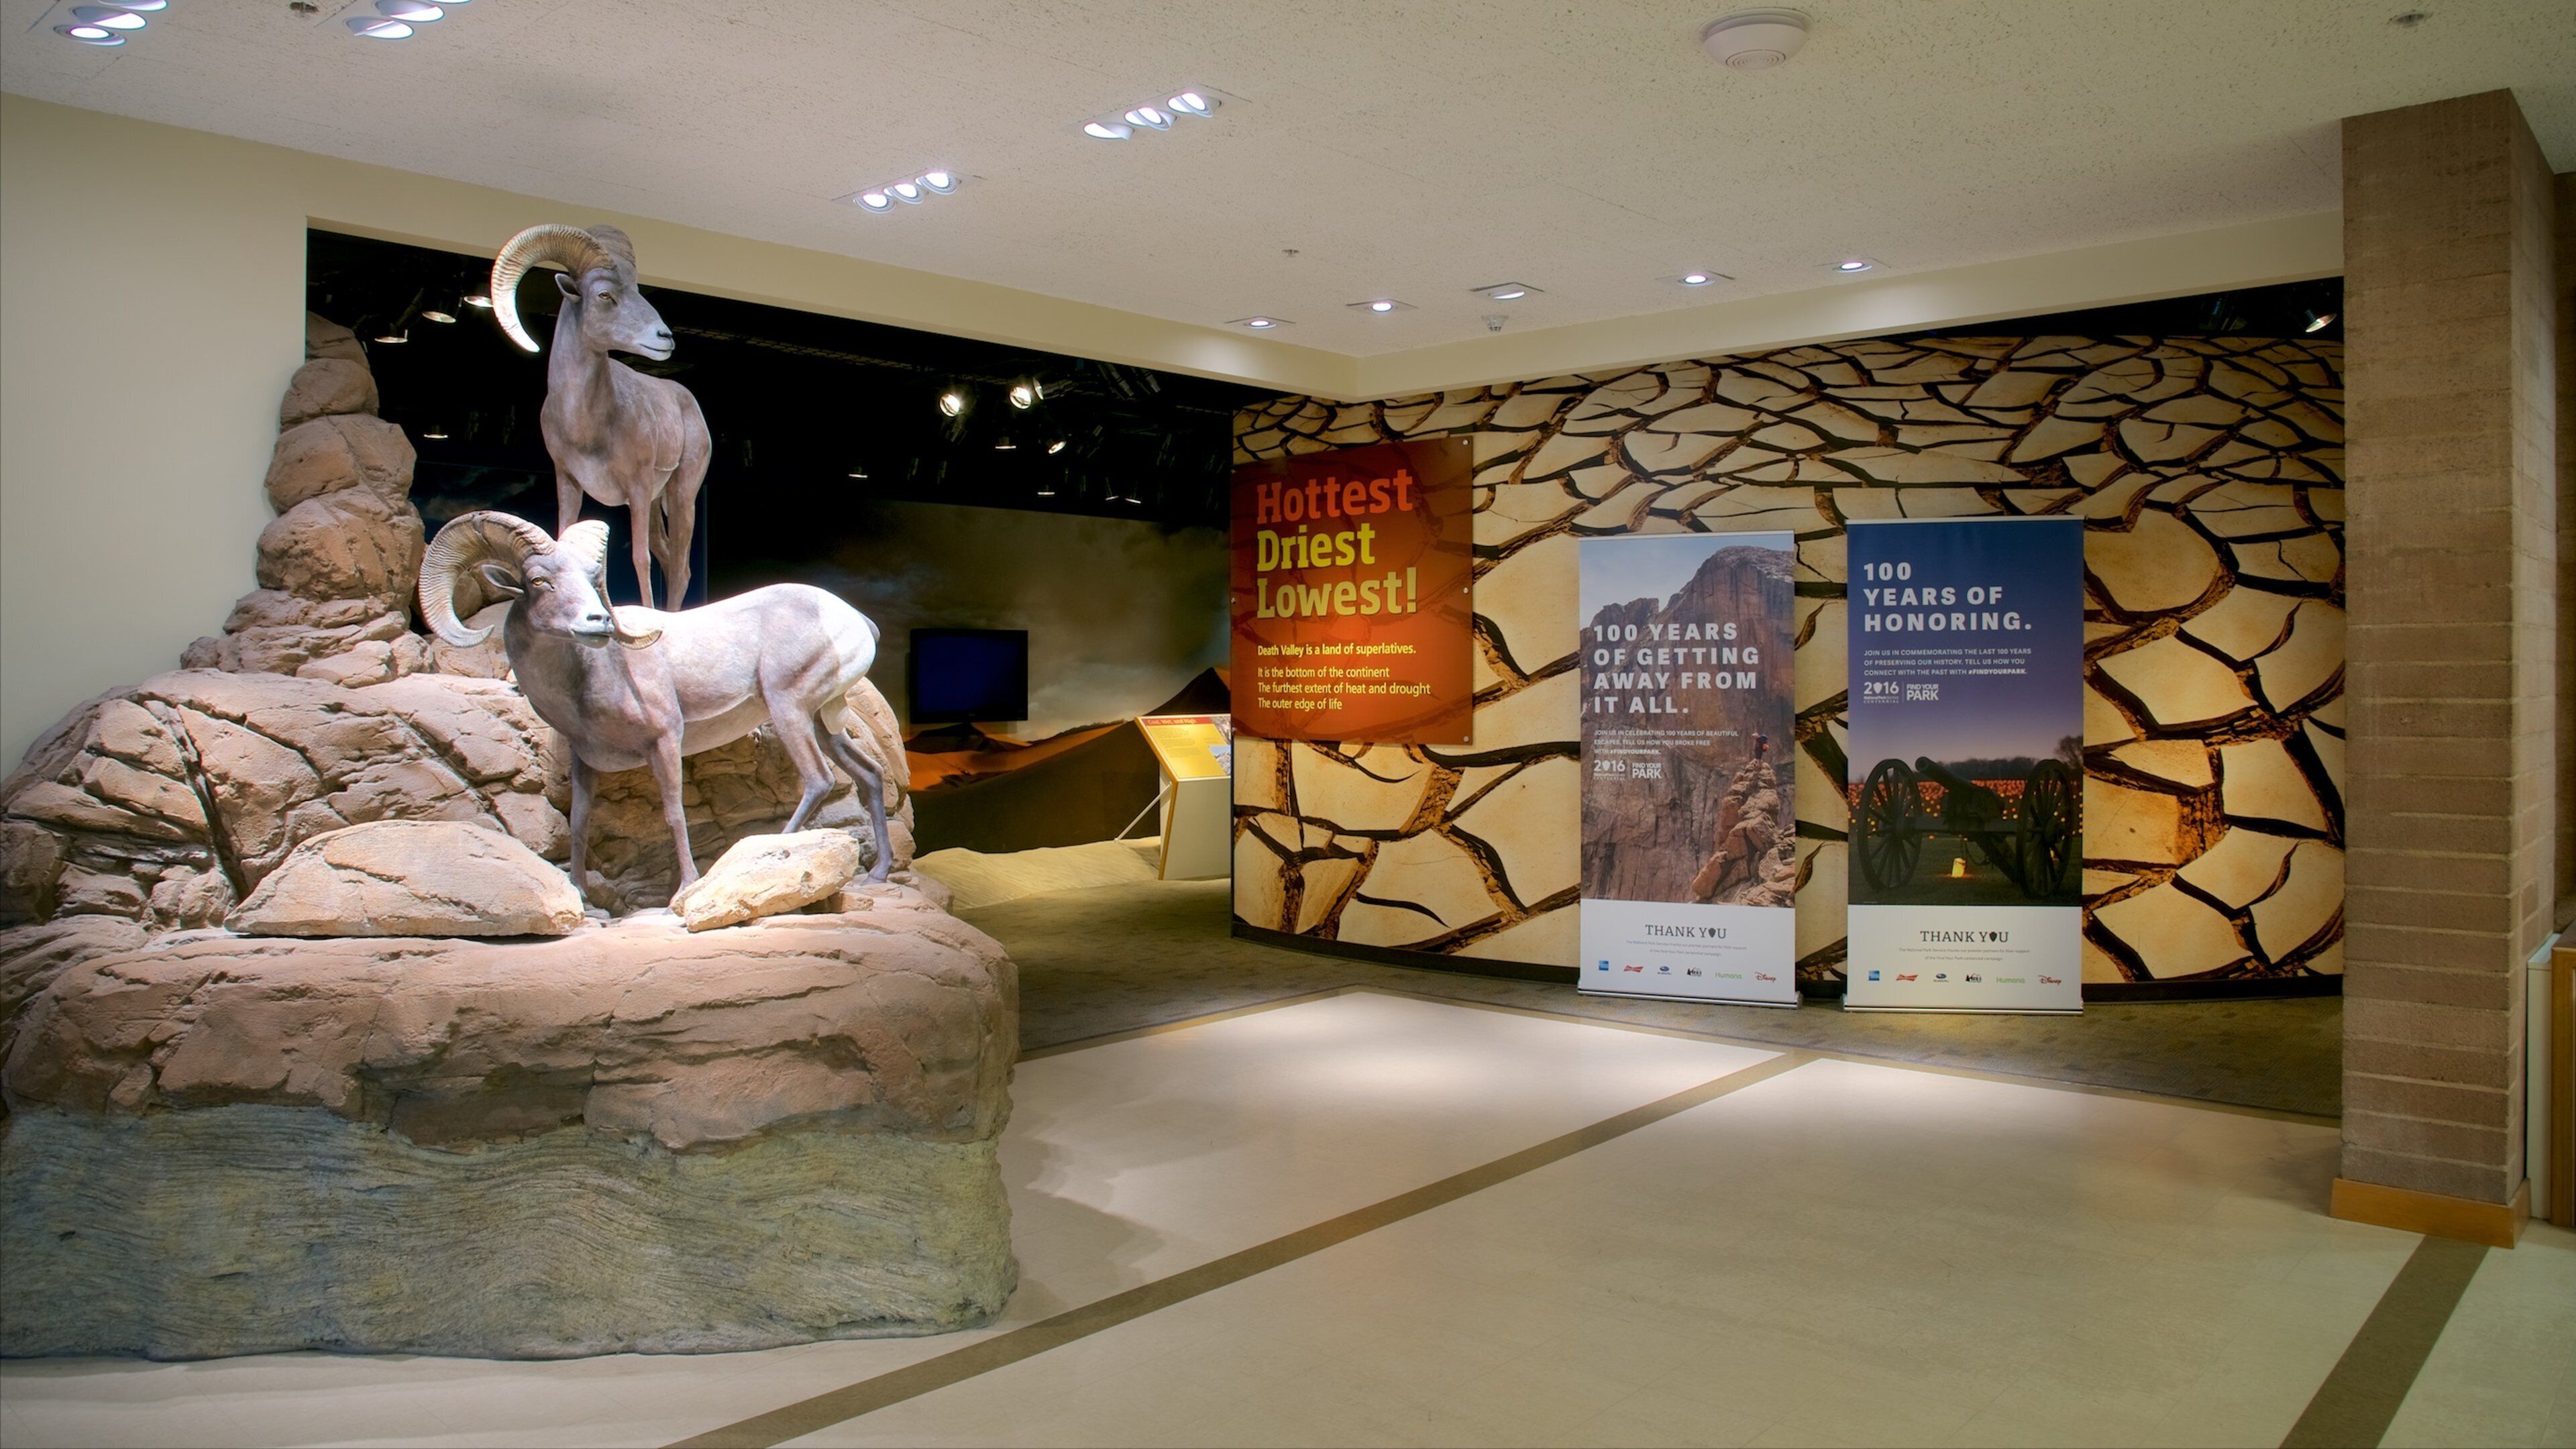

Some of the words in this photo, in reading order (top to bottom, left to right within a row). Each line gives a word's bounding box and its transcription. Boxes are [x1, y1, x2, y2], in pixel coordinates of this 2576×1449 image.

[1257, 469, 1413, 524] Hottest
[1257, 523, 1375, 572] Driest
[1864, 562, 1911, 581] 100
[1257, 567, 1417, 619] Lowest!
[1863, 587, 1956, 606] YEARS
[1967, 586, 2002, 605] OF
[1864, 612, 2032, 631] HONORING.
[1594, 625, 1638, 641] 100
[1649, 623, 1737, 641] YEARS
[1258, 645, 1279, 655] Death
[1281, 644, 1303, 657] Valley
[1305, 644, 1312, 655] is
[1315, 647, 1320, 655] a
[1322, 643, 1341, 655] land
[1344, 643, 1354, 654] of
[1356, 642, 1416, 657] superlatives.
[1594, 649, 1626, 665] OF
[1637, 647, 1759, 665] GETTING
[1258, 667, 1263, 678] It
[1265, 667, 1270, 678] is
[1271, 666, 1283, 678] the
[1285, 666, 1315, 678] bottom
[1317, 665, 1327, 678] of
[1329, 666, 1344, 678] the
[1346, 666, 1390, 678] continent
[1258, 682, 1271, 693] The
[1272, 682, 1302, 693] furthest
[1304, 684, 1331, 694] extent
[1333, 682, 1344, 694] of
[1346, 682, 1366, 694] heat
[1368, 682, 1387, 694] and
[1389, 682, 1431, 697] drought
[1593, 672, 1670, 690] AWAY
[1681, 672, 1757, 690] FROM
[1907, 690, 1939, 700] PARK
[1258, 697, 1271, 708] The
[1272, 700, 1293, 708] outer
[1294, 698, 1315, 711] edge
[1317, 698, 1327, 709] of
[1329, 698, 1342, 710] life
[1595, 696, 1619, 713] IT
[1629, 696, 1688, 713] ALL.
[1632, 769, 1662, 778] PARK
[1646, 924, 1695, 937] THANK
[1920, 931, 1975, 943] THANK
